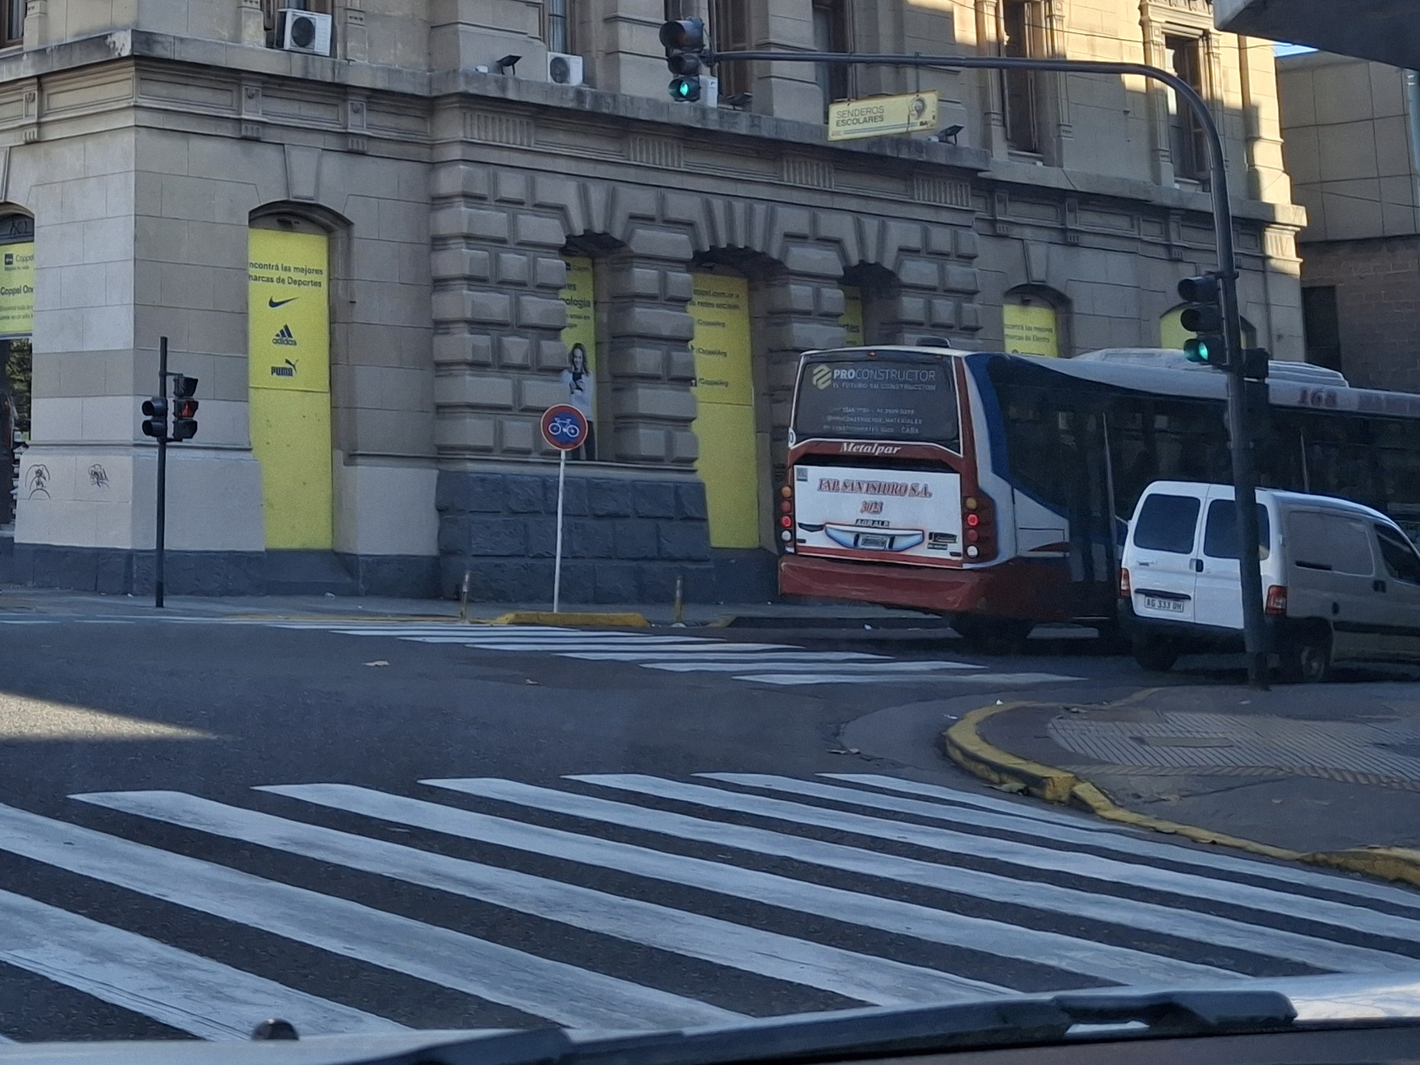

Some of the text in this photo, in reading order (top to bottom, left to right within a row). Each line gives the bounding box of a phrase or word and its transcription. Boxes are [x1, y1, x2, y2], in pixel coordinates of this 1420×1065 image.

[836, 105, 884, 119] SENDEROS
[836, 115, 884, 127] ESCOLARES
[249, 262, 323, 276] ncontrá las mejores
[276, 276, 285, 285] de
[287, 276, 322, 287] Deportes
[0, 285, 21, 297] Coppel
[271, 366, 293, 377] PUMA
[833, 368, 936, 381] PROCONSTRUCTOR
[840, 442, 901, 455] Metalpar
[1158, 599, 1171, 610] 333
